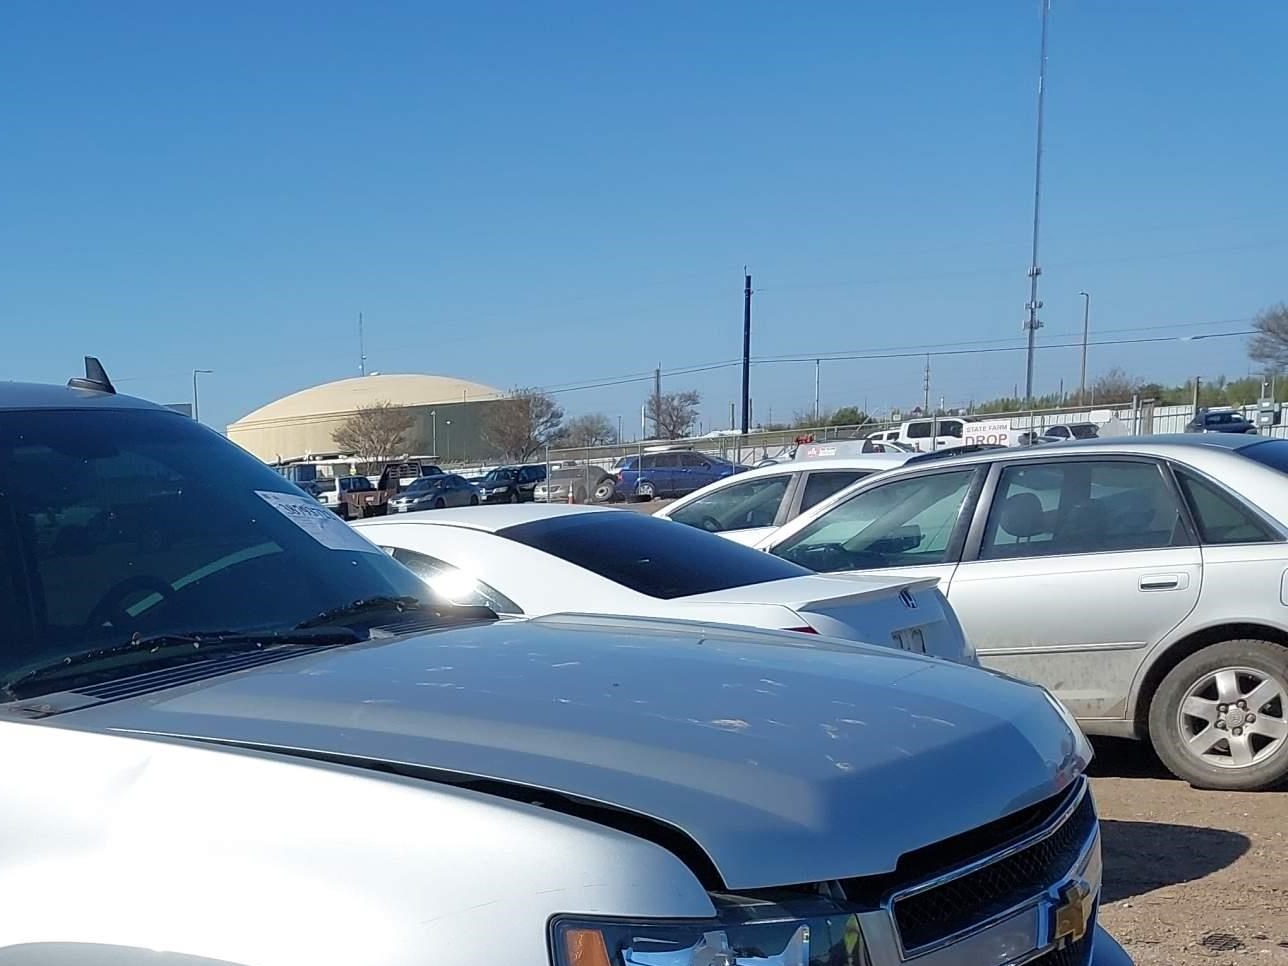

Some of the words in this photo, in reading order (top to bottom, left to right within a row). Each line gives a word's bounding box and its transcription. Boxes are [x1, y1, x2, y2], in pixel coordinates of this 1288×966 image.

[966, 425, 987, 433] STATE
[987, 423, 1008, 431] FARM
[965, 433, 1008, 446] DROP
